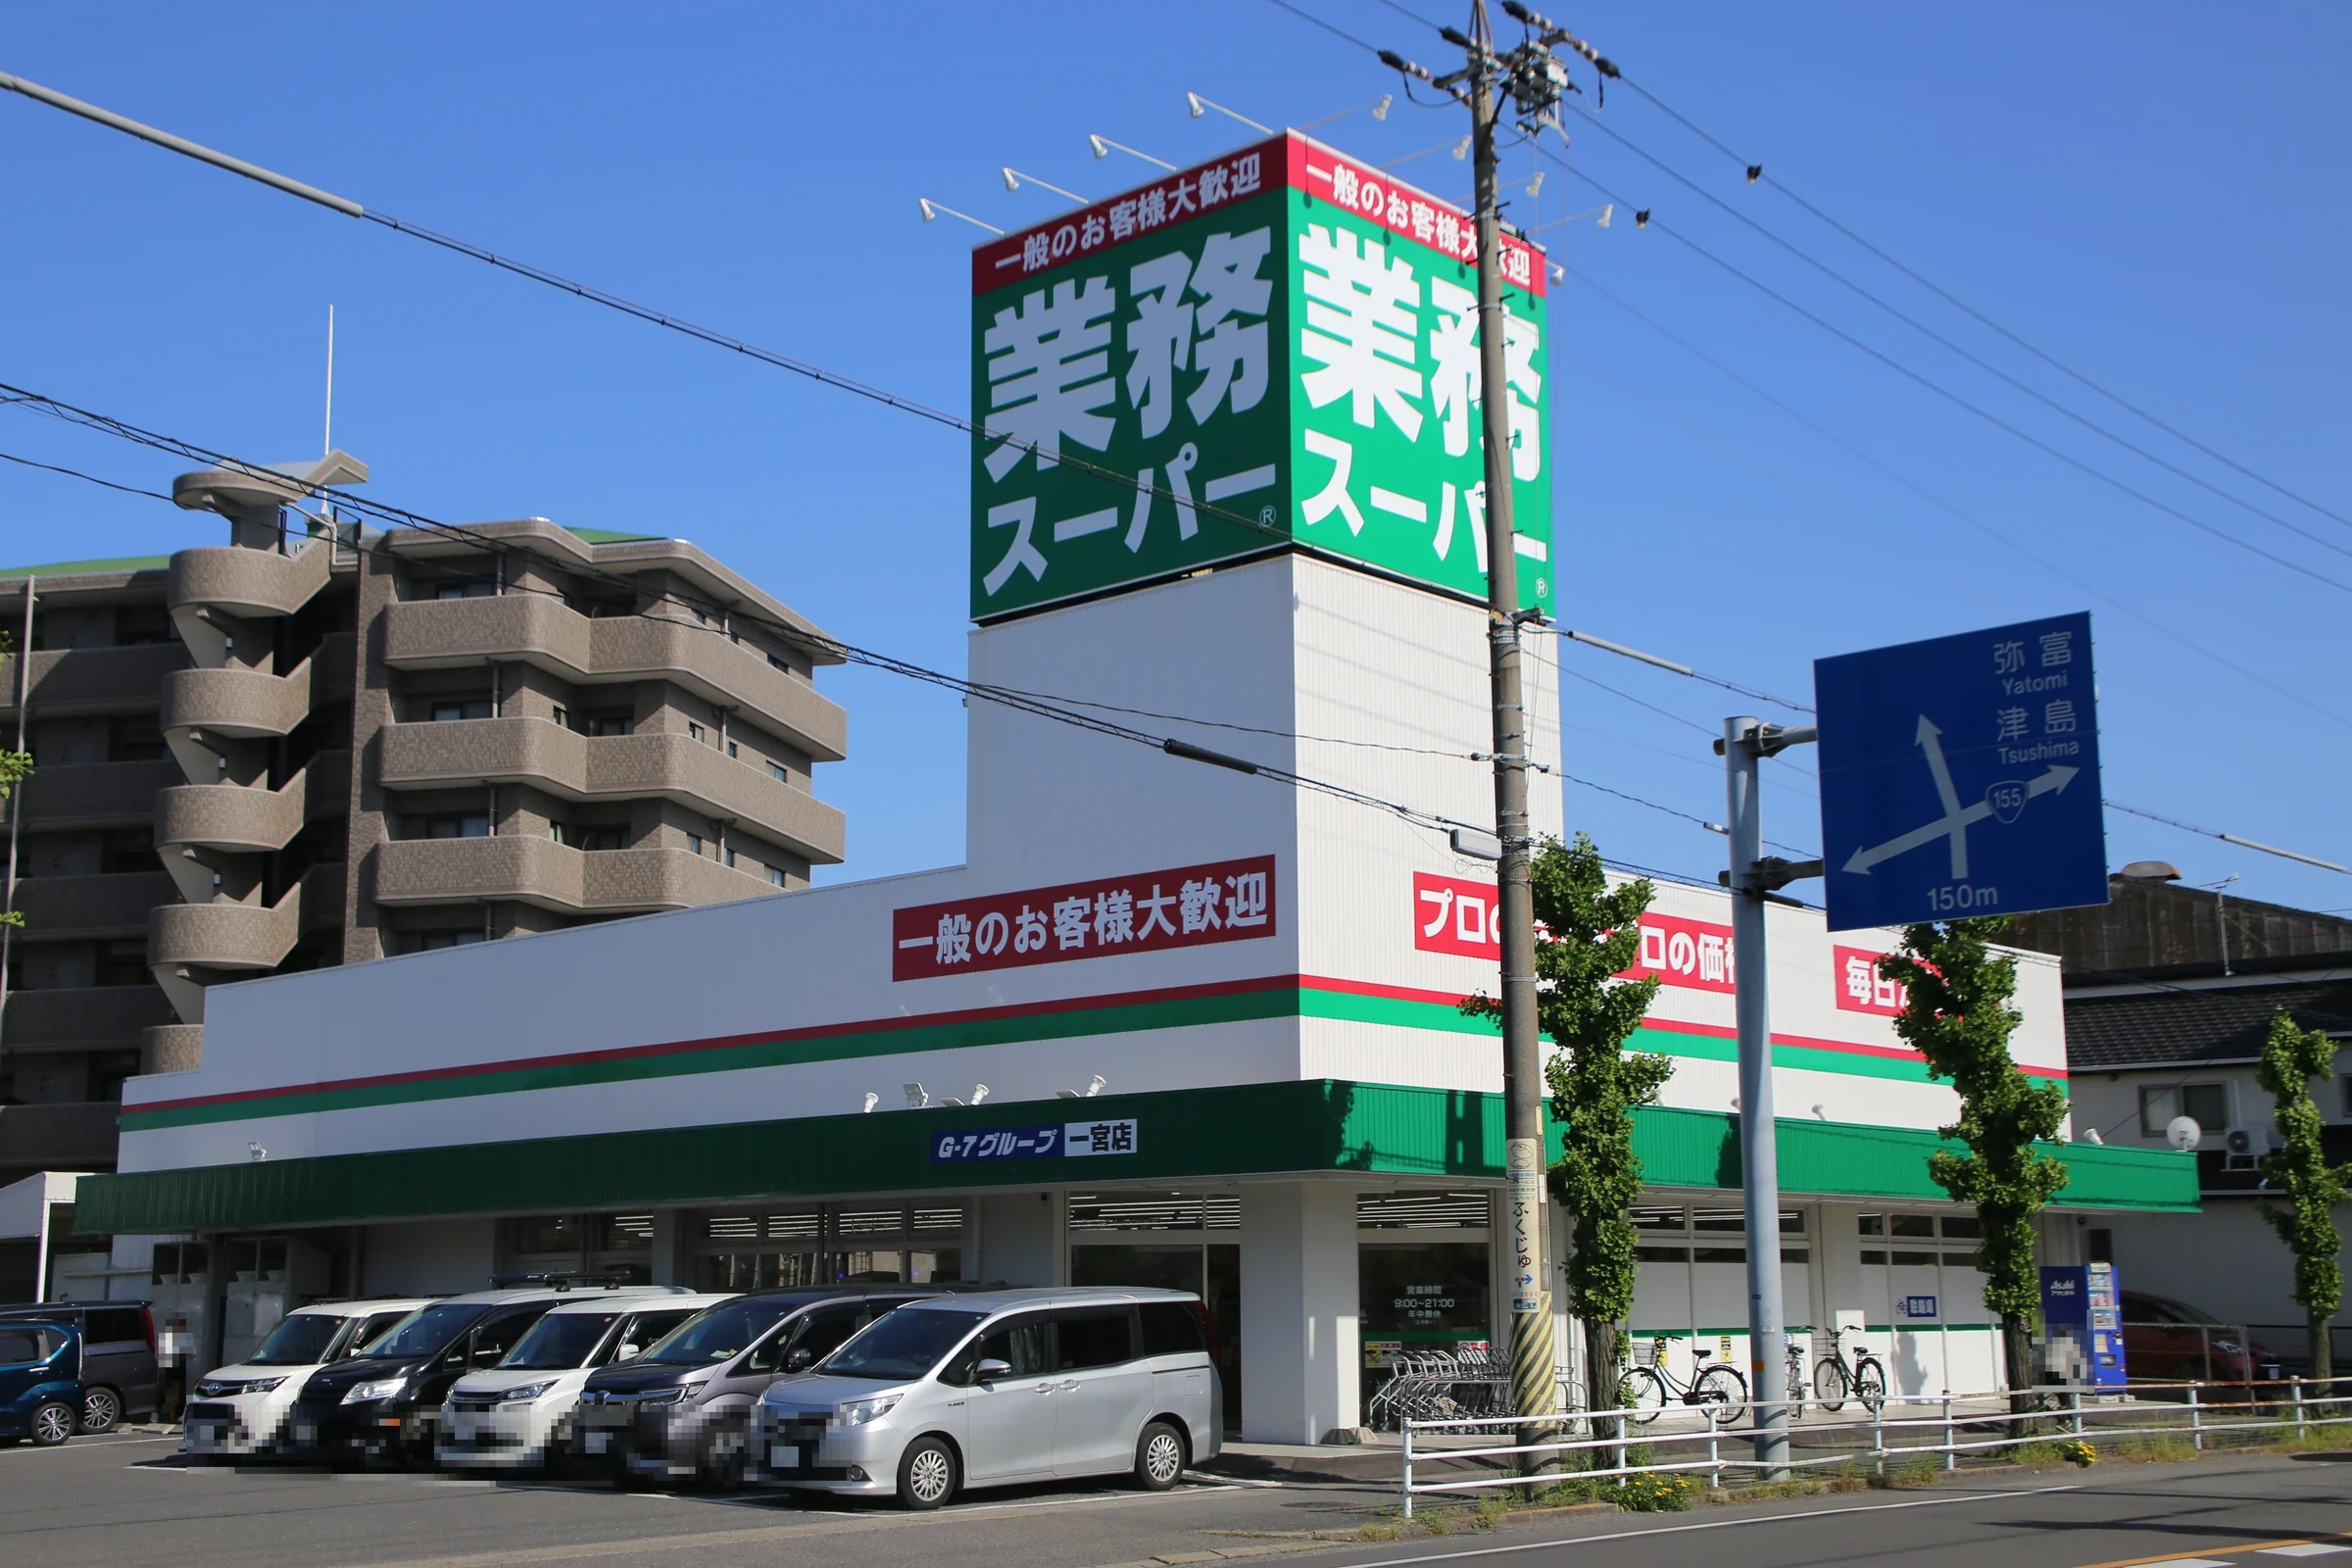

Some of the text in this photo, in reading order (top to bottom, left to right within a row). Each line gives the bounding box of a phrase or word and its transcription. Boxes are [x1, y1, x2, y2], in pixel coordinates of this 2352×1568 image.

[995, 152, 1261, 272] 一般のお客様大歓迎
[982, 225, 1272, 484] 業務
[1298, 221, 1543, 482] 業務
[982, 442, 1276, 597] スーパー
[1993, 631, 2072, 674] 弥富
[2001, 669, 2069, 696] Yatomi
[1997, 699, 2077, 742] 津島
[1997, 741, 2080, 764] Tsushima
[1992, 787, 2022, 808] 155
[899, 871, 1268, 964] 一般のお客様大歓迎
[1927, 884, 1998, 911] 150m
[938, 1122, 1132, 1158] G-7グループ 一宮店
[1512, 1201, 1532, 1268] ふくじゅ
[1406, 1286, 1442, 1295] 営業時間
[2050, 1280, 2075, 1290] Asahi
